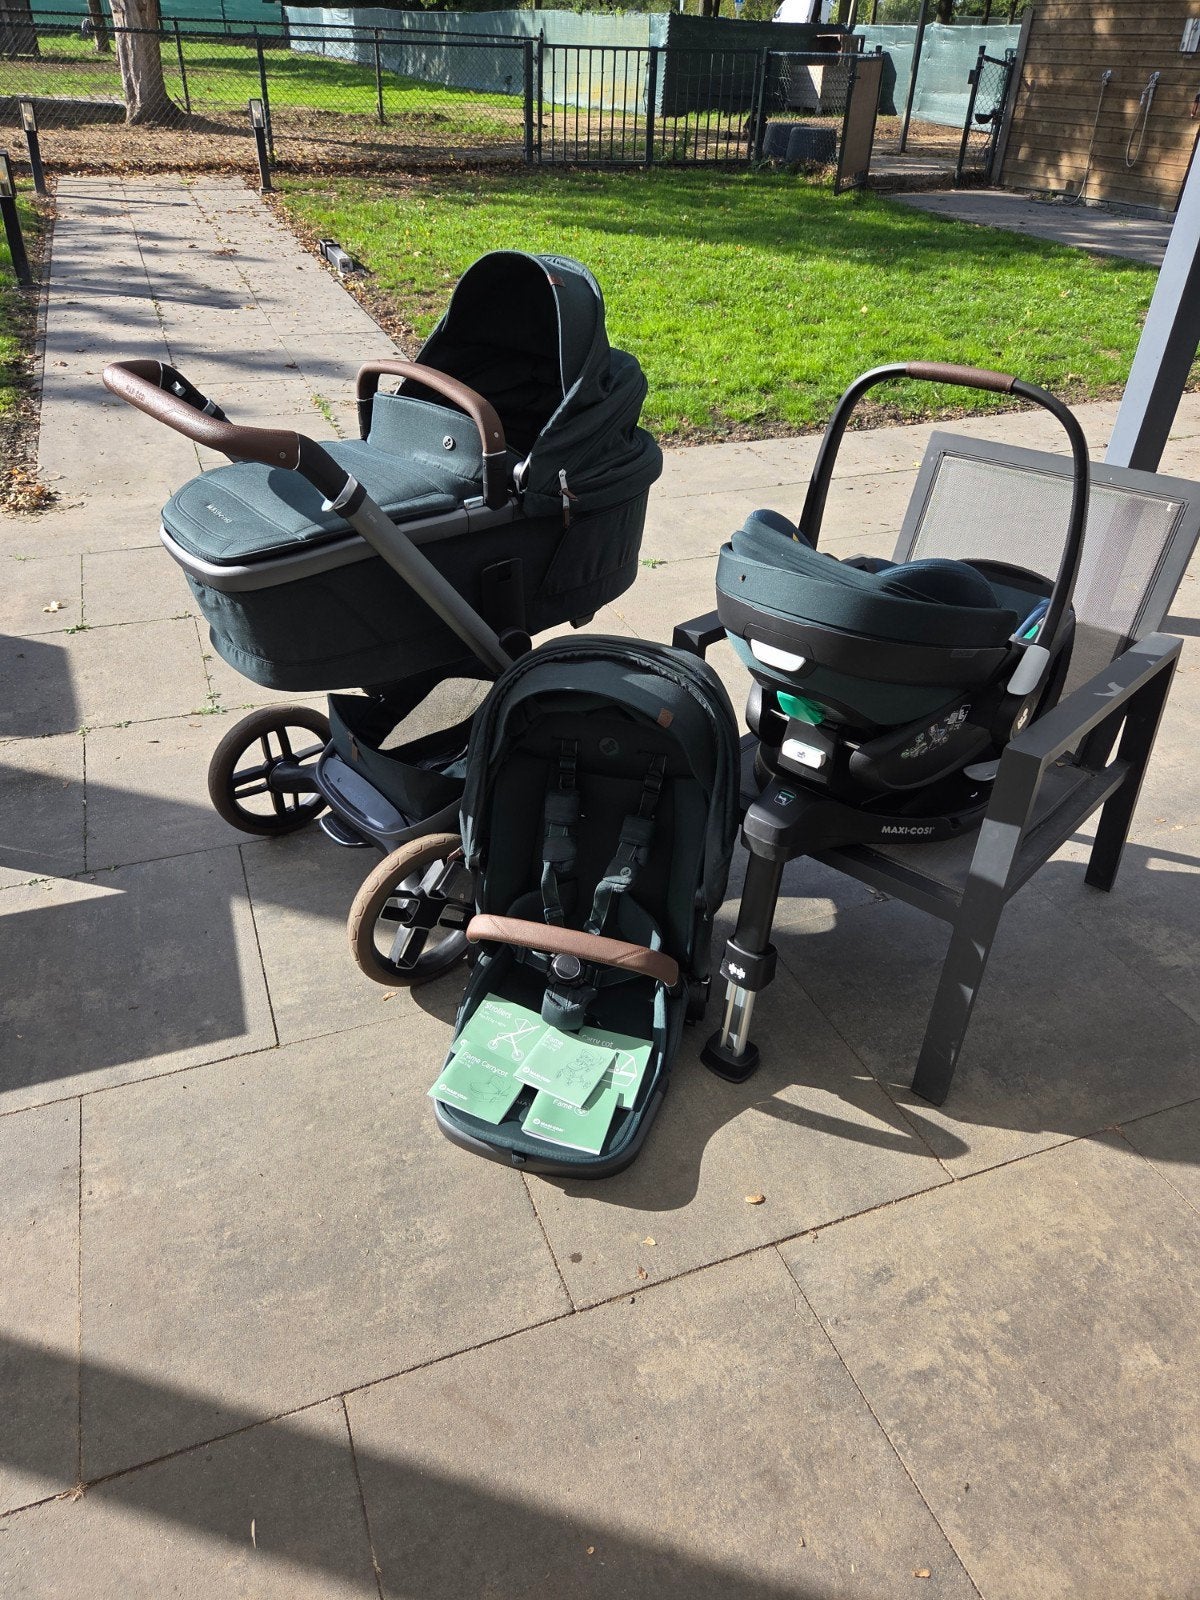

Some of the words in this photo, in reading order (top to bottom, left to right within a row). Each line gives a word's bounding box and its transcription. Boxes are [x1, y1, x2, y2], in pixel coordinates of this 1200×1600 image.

[881, 825, 933, 835] MAXI-COSI
[484, 1001, 513, 1019] Strollers
[462, 1051, 481, 1064] Fame
[481, 1060, 509, 1077] Carrycot
